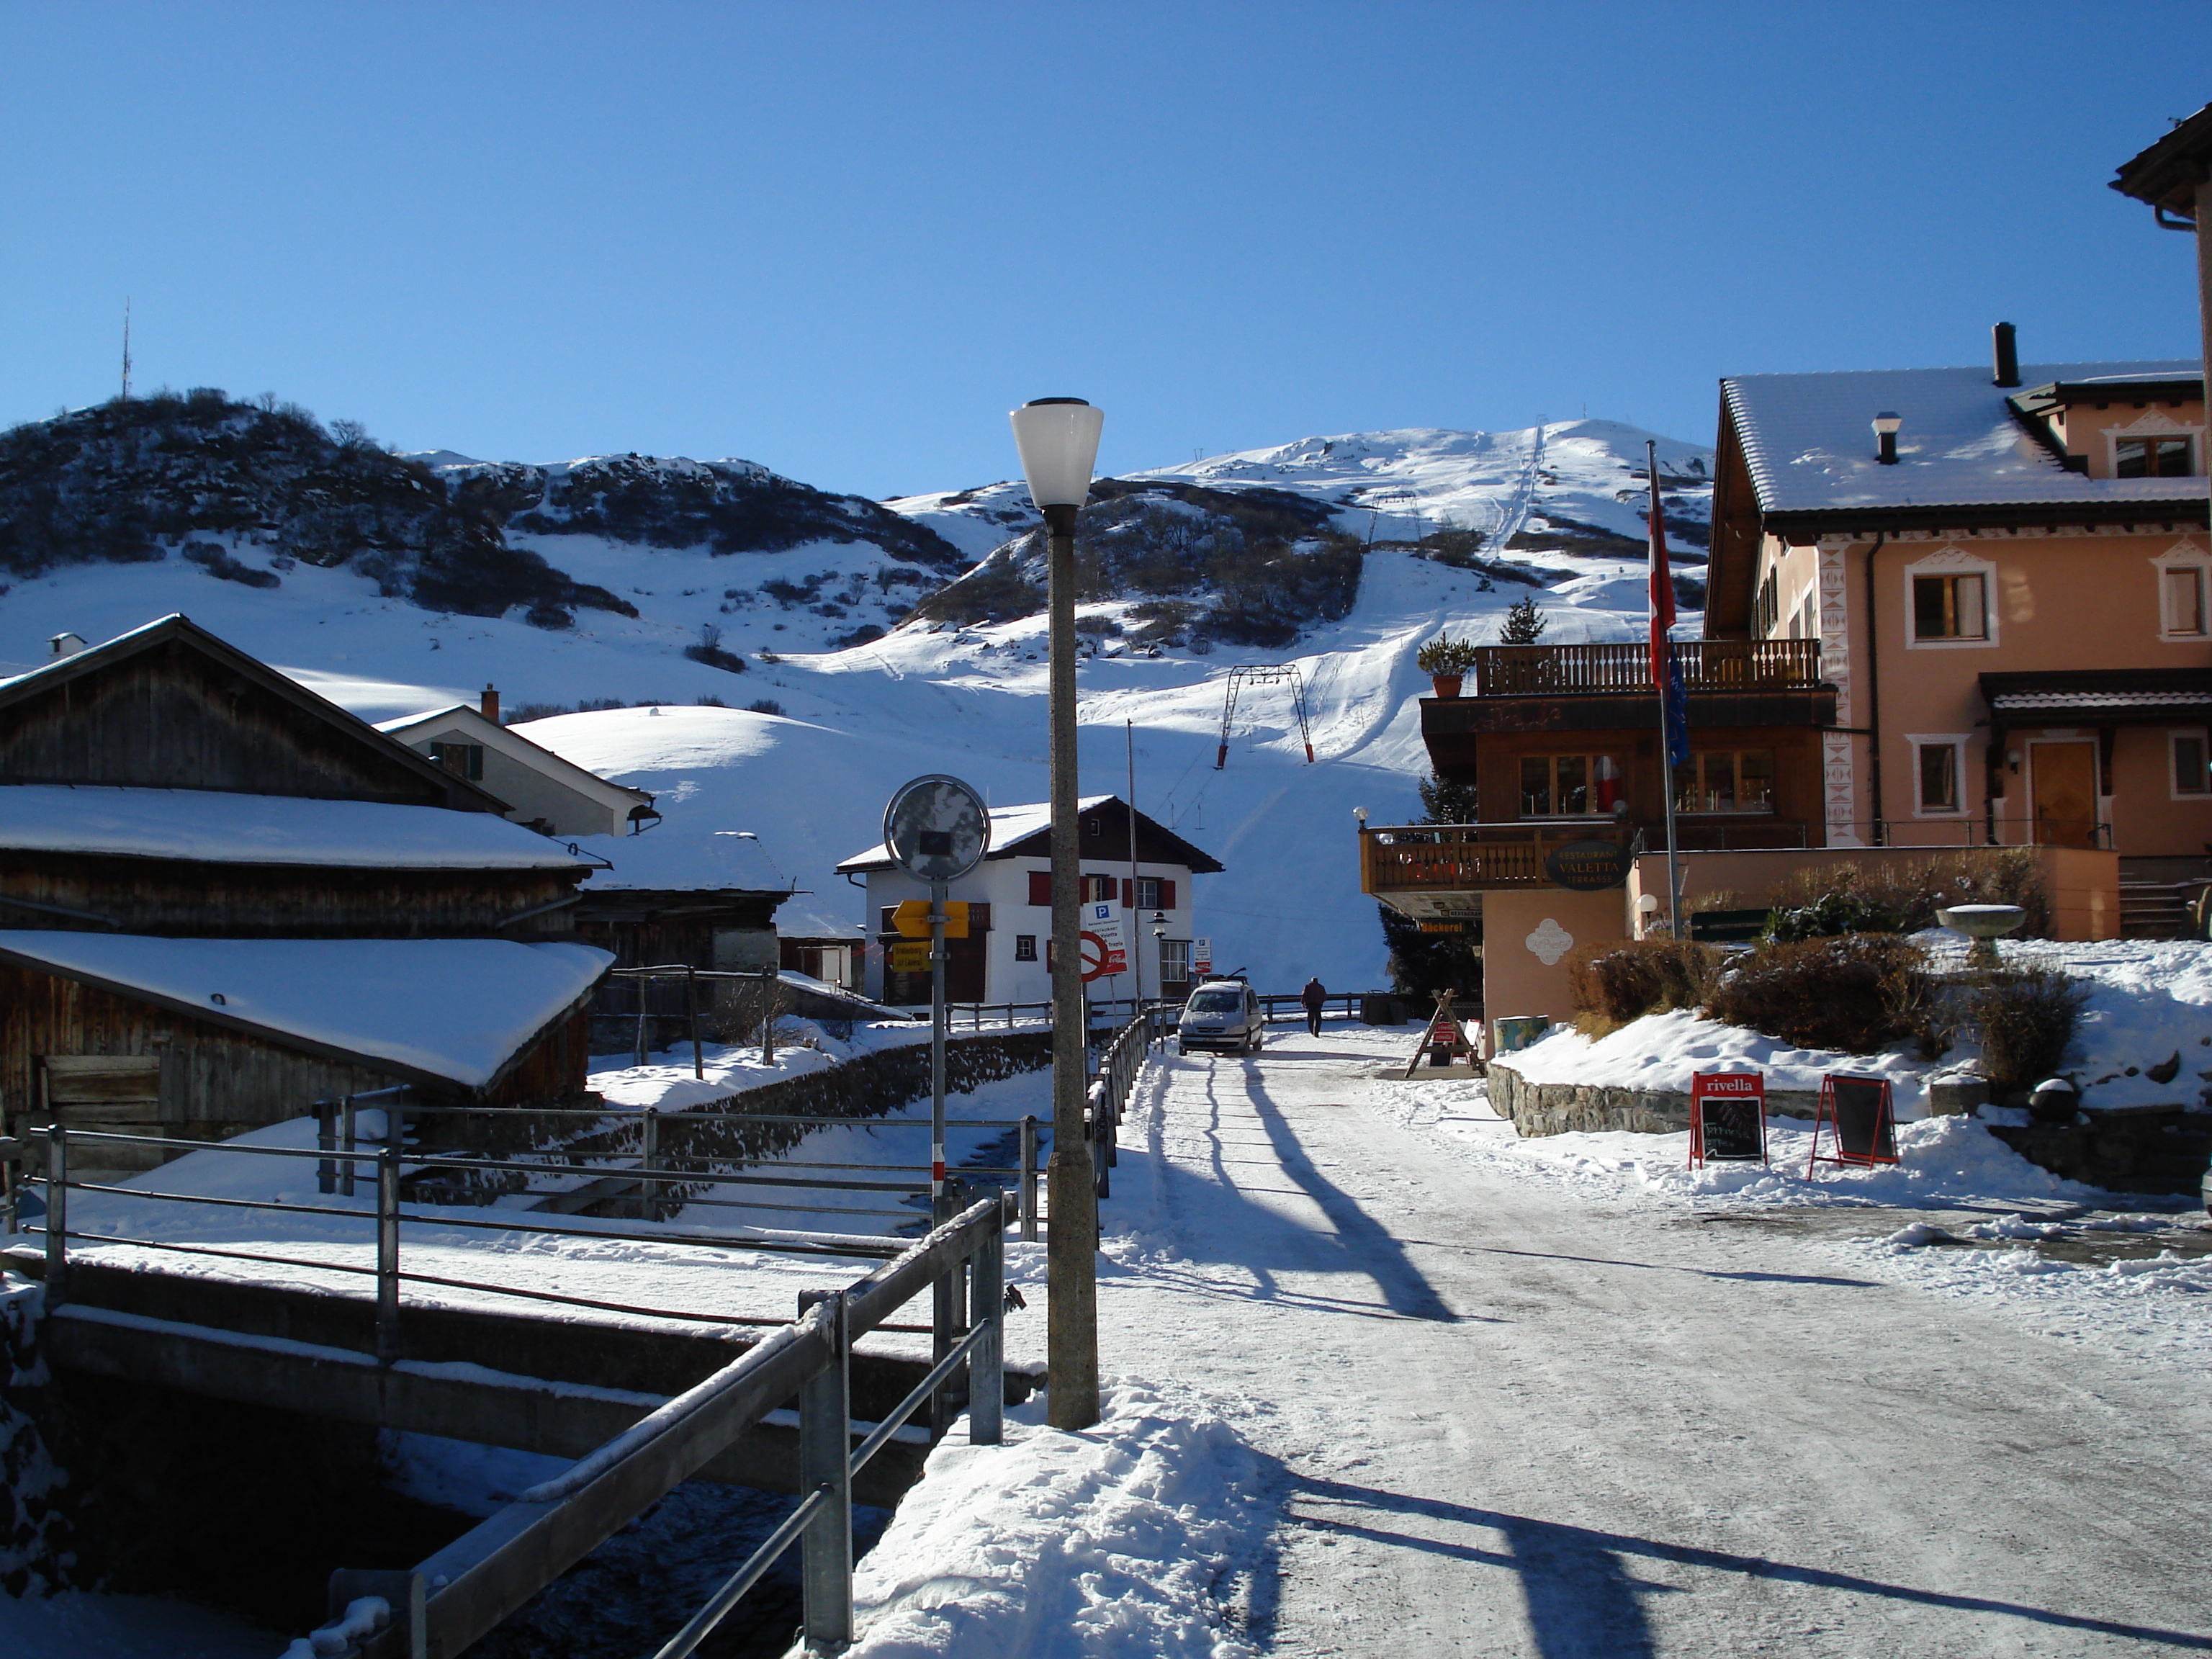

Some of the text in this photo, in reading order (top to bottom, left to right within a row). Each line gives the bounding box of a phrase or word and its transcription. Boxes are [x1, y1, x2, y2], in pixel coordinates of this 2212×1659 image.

[1559, 851, 1617, 860] RESTAURANT
[1559, 862, 1619, 873] VALETTA
[1567, 876, 1612, 884] TERRASSE
[1098, 907, 1107, 917] P
[1422, 922, 1462, 932] Bäckerei
[1707, 1079, 1753, 1091] rivella
